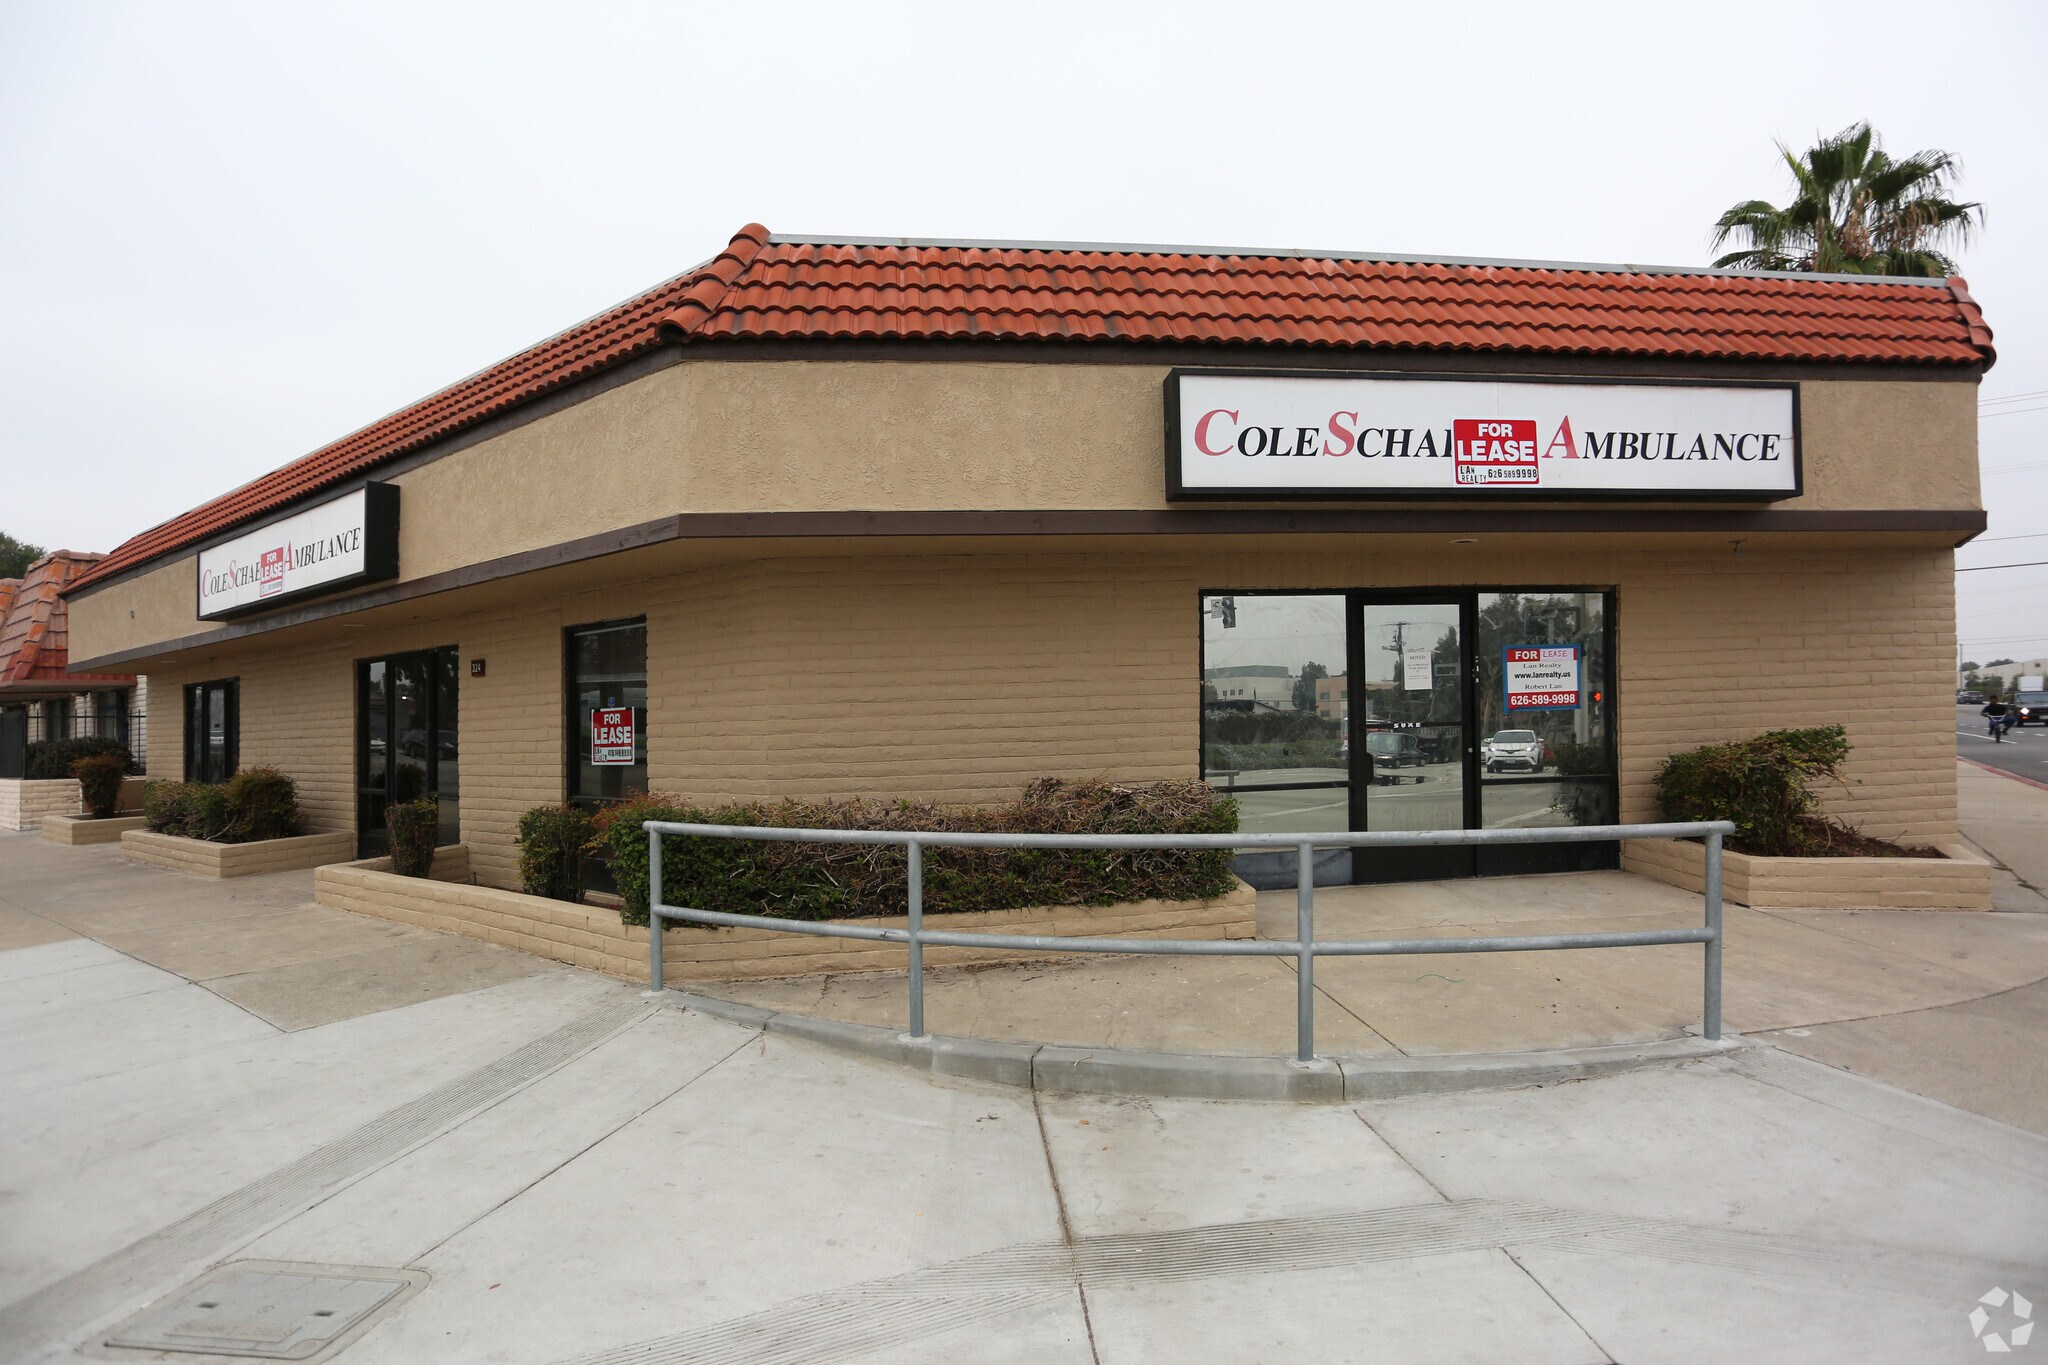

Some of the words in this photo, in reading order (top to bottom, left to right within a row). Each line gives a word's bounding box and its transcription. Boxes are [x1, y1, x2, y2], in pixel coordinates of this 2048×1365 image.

[1477, 423, 1513, 438] FOR
[1541, 414, 1781, 461] AMBULANCE
[1457, 440, 1536, 462] LEASE
[1461, 474, 1487, 484] REALTY
[283, 526, 361, 573] AMBULANCE
[266, 551, 277, 564] FOR
[260, 561, 283, 580] LEASE
[1515, 650, 1538, 660] FOR
[1542, 650, 1569, 658] LEASE
[1514, 670, 1571, 679] www.lanrealty.us
[1511, 693, 1576, 705] 626-589-9998
[603, 713, 621, 725] FOR
[594, 726, 632, 744] LEASE
